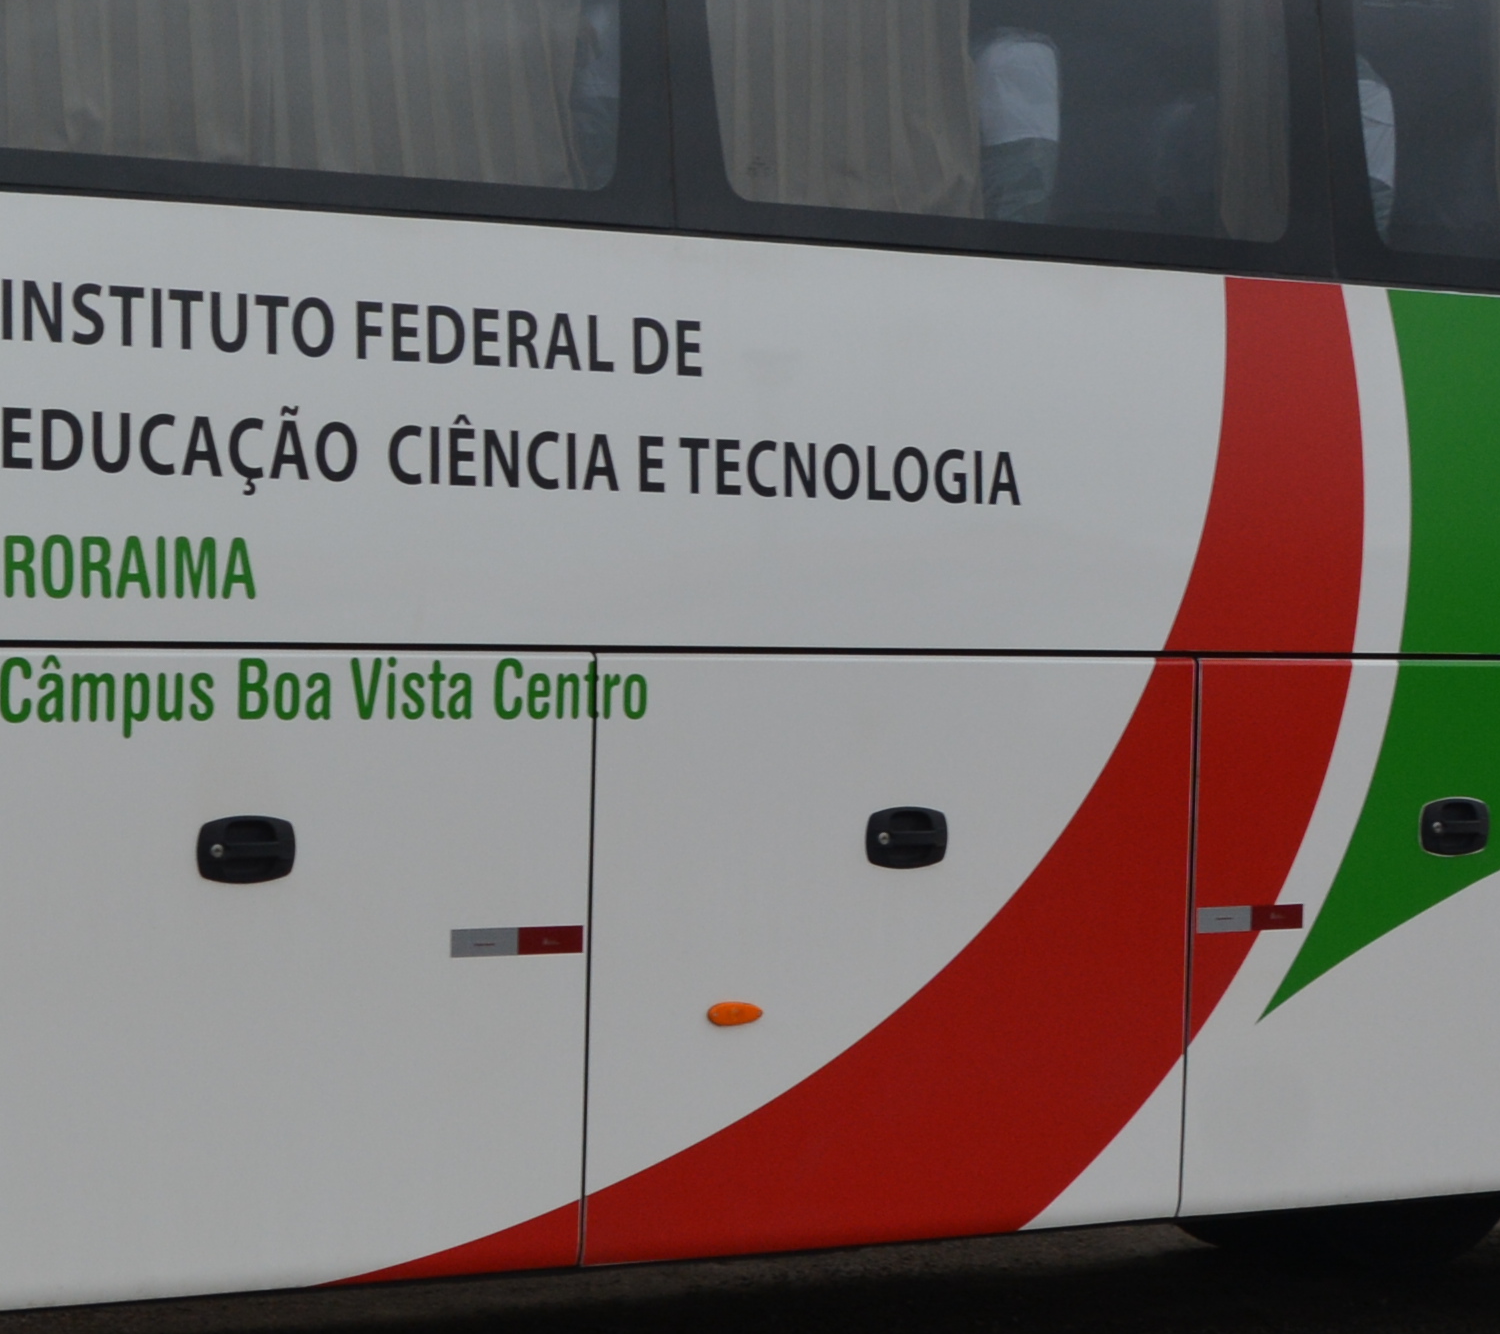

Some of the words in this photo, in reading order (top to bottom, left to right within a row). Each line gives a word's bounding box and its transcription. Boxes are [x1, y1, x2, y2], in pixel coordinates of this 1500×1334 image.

[2, 279, 334, 357] INSTITUTO
[357, 301, 614, 372] FEDERAL
[633, 318, 702, 376] DE
[3, 406, 357, 495] EDUCAÇÃO
[389, 414, 619, 491] CIÊNCIA
[639, 436, 665, 492] E
[679, 438, 1020, 505] TECNOLOGIA
[5, 535, 256, 598] RORAIMA
[0, 655, 214, 736] Câmpus
[239, 657, 331, 720] Boa
[351, 657, 472, 719] Vista
[494, 657, 648, 719] Centro
